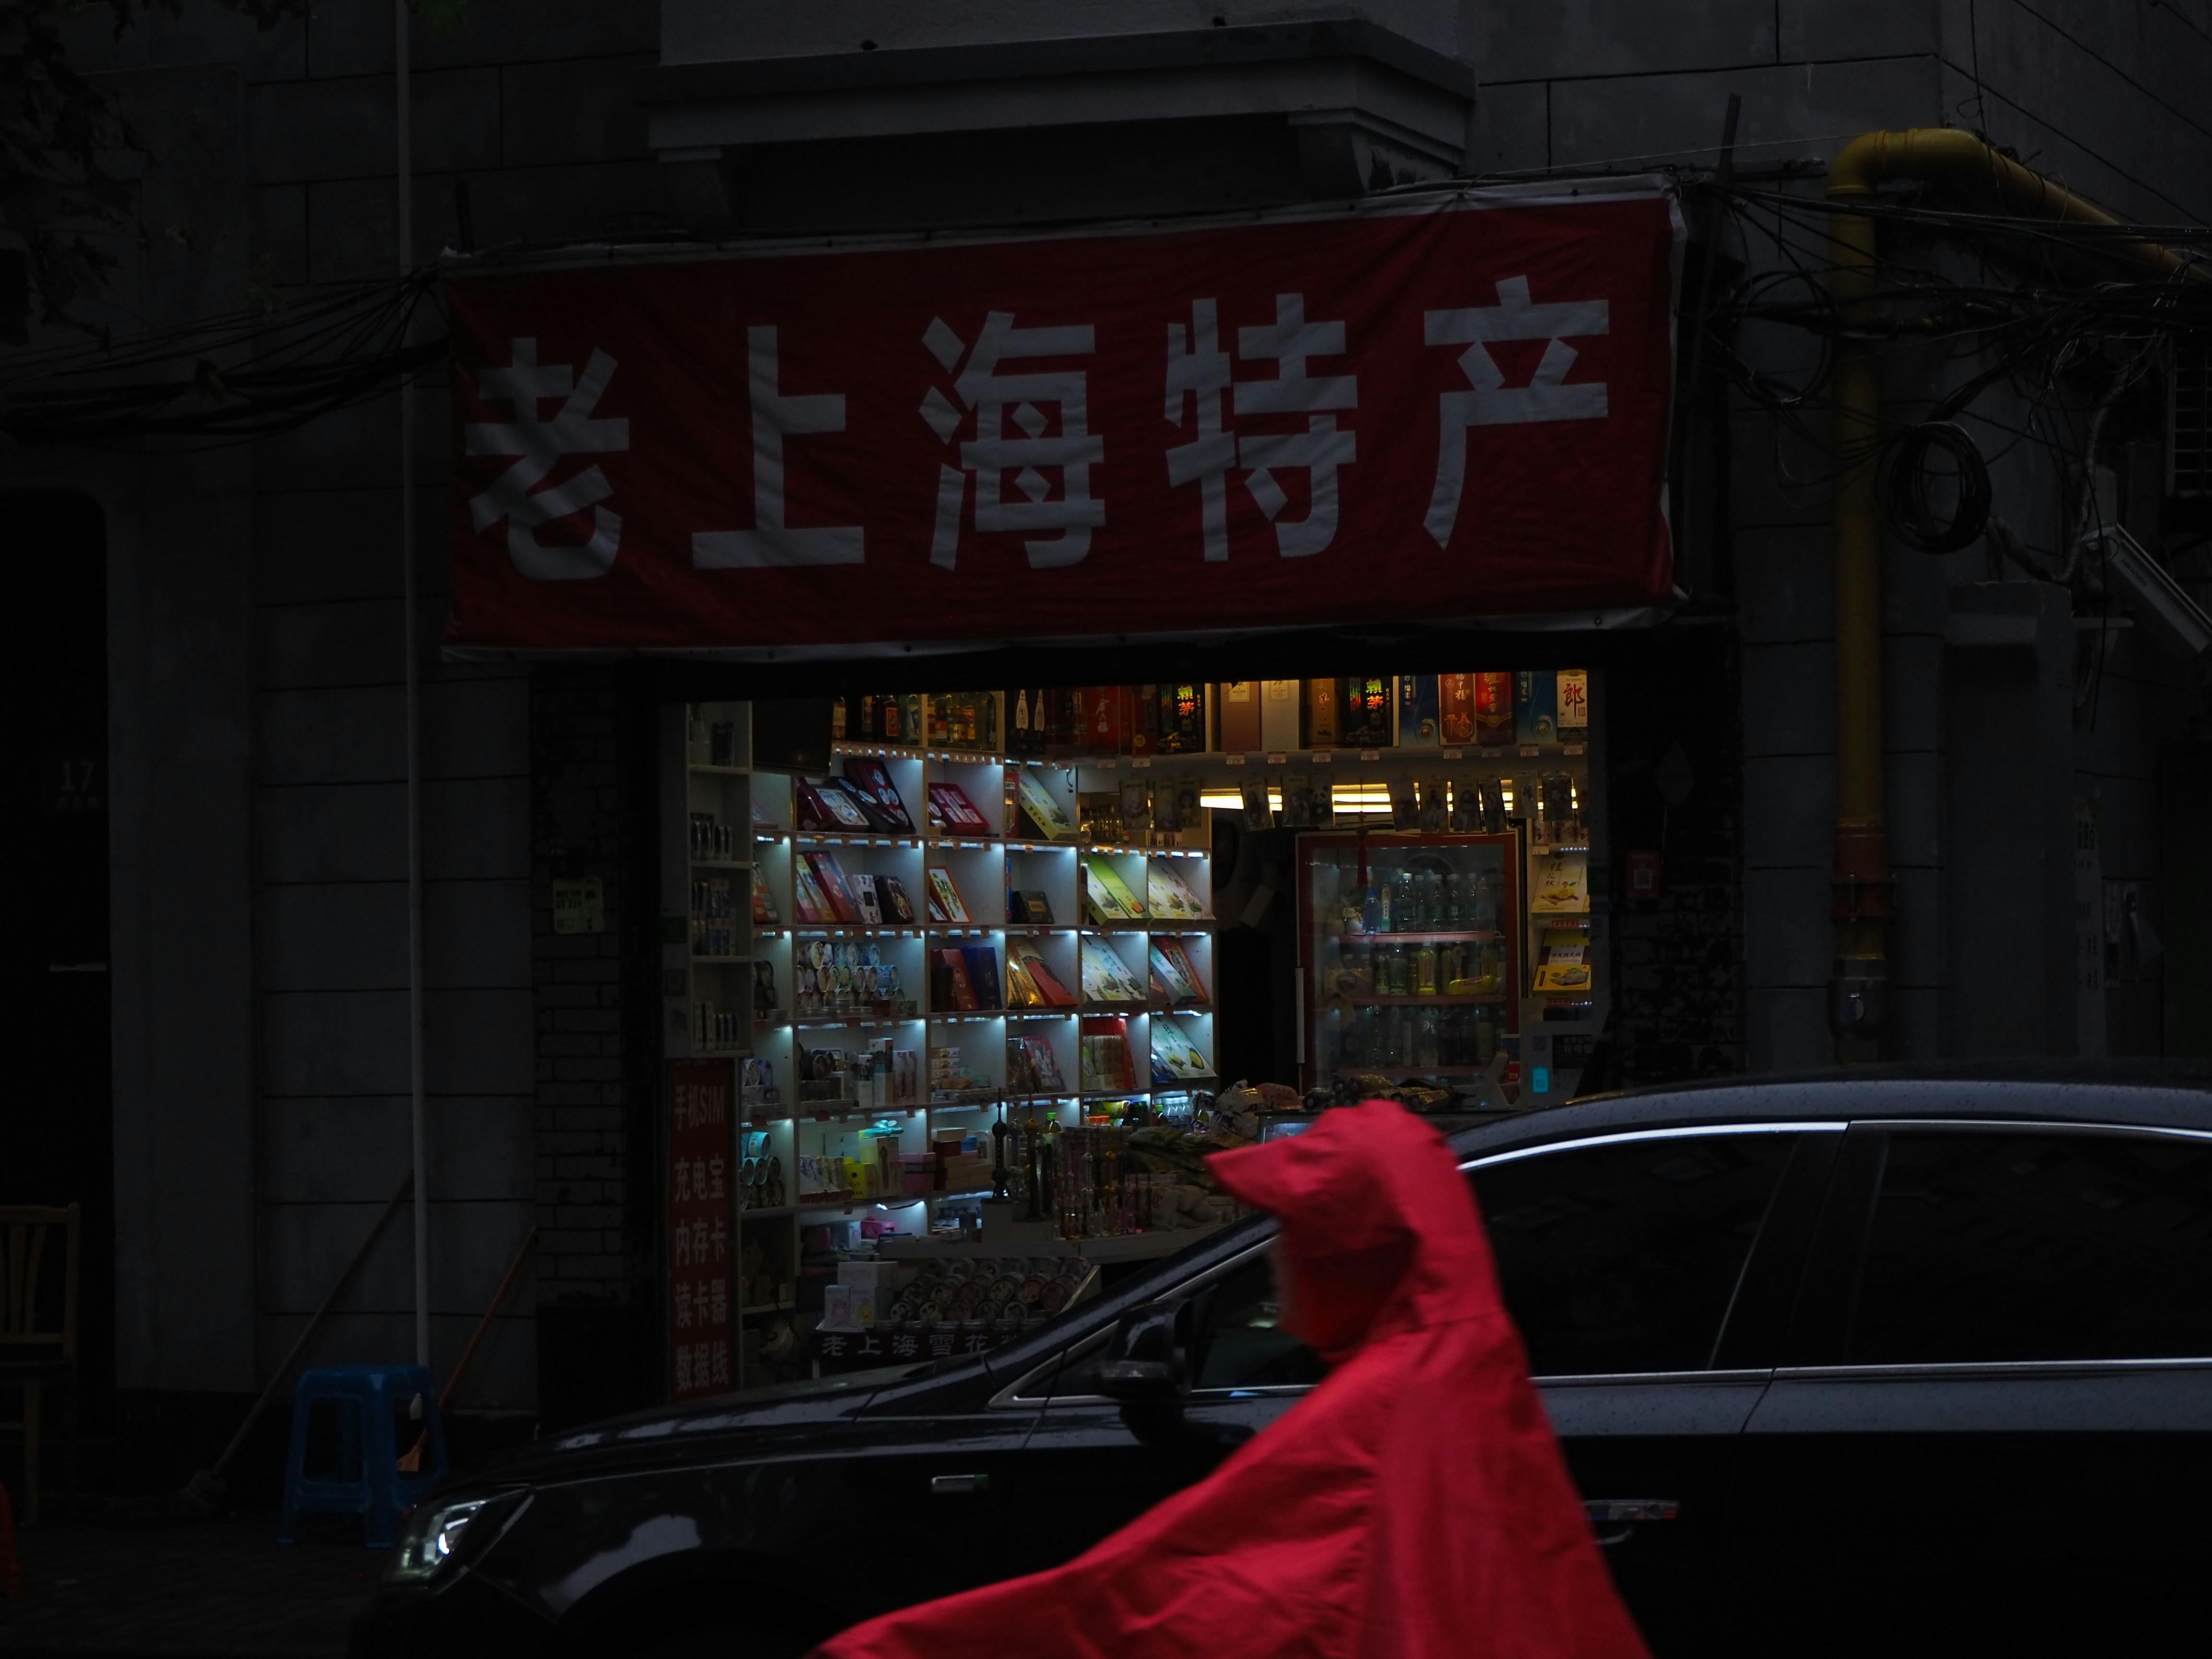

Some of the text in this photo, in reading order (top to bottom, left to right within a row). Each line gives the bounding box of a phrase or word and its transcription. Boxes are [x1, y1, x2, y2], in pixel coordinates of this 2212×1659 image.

[464, 274, 1610, 581] 老上海特产
[1563, 683, 1585, 719] 郎
[60, 760, 95, 793] 17
[675, 1083, 725, 1130] 手机SIM
[675, 1153, 725, 1203] 充电宝
[676, 1216, 726, 1266] 内存卡
[676, 1278, 727, 1328] 读卡器
[676, 1340, 729, 1393] 数据线
